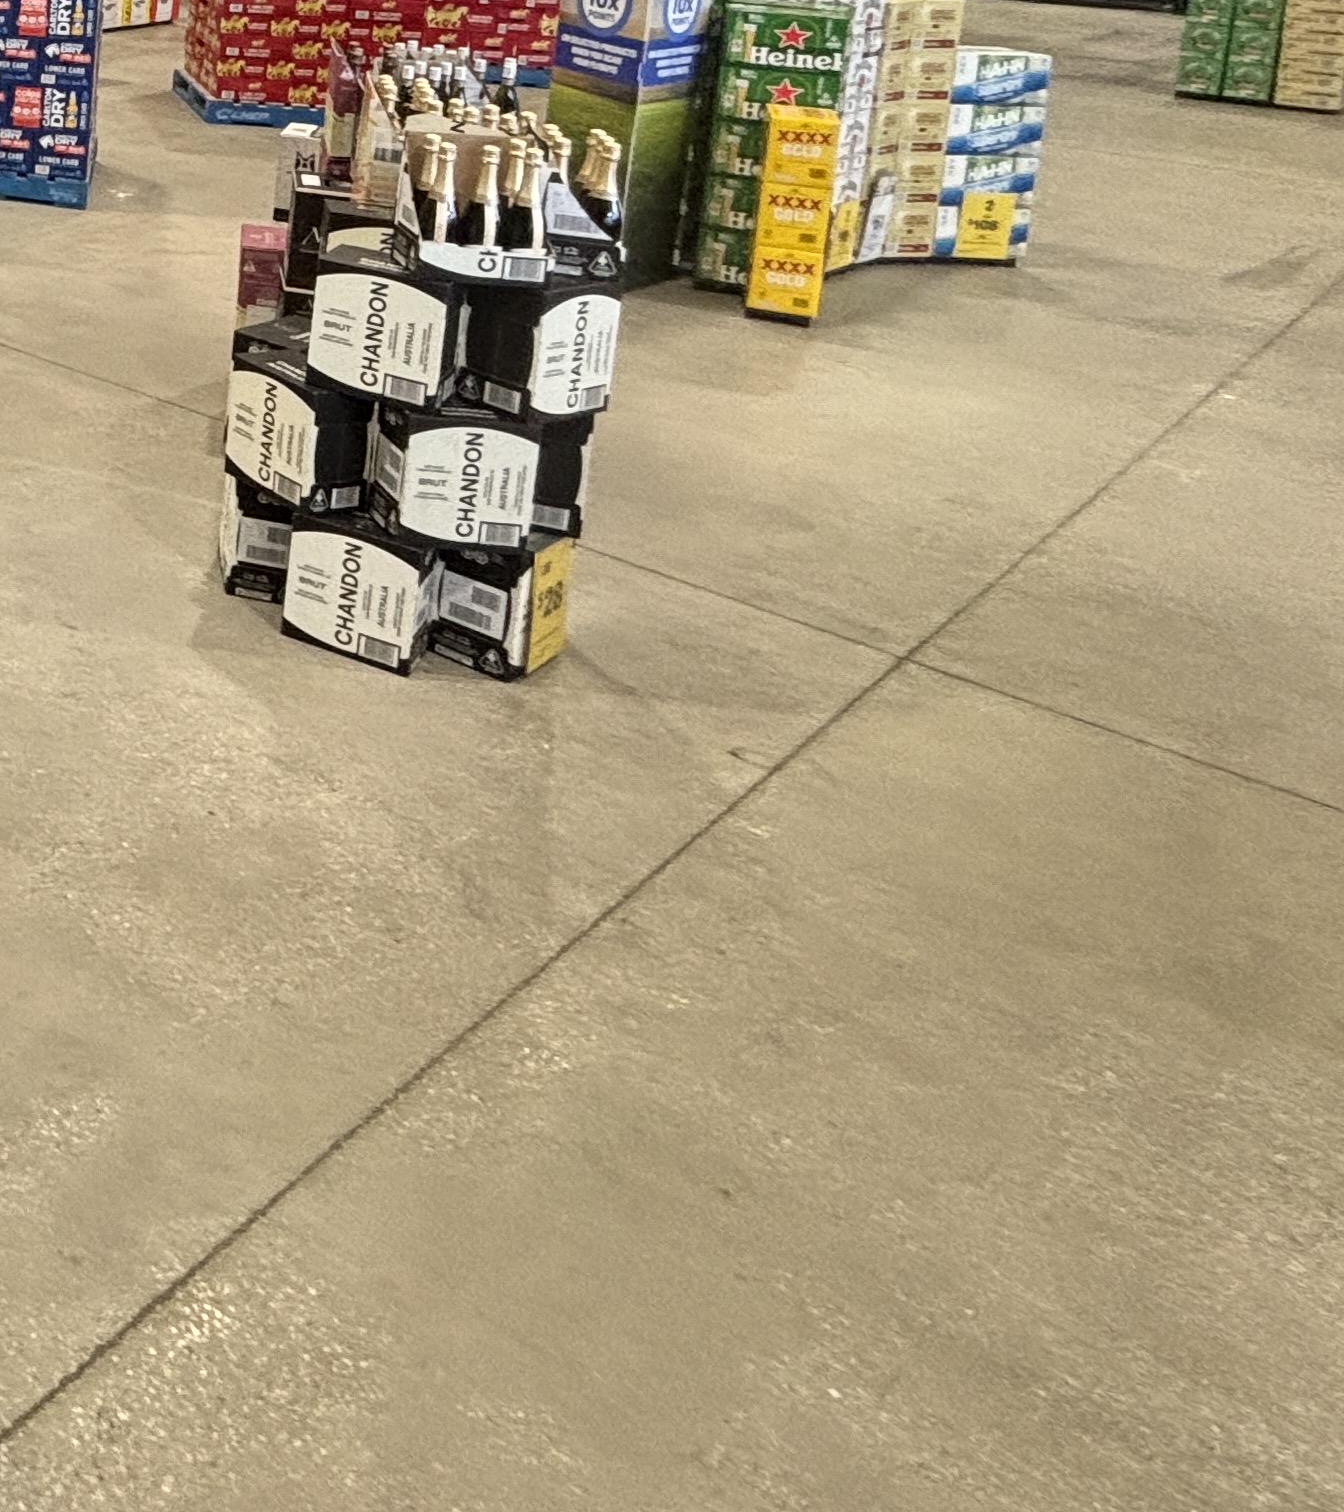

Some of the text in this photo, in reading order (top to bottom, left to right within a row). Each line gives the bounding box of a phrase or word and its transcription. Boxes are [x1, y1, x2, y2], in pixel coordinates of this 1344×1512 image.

[51, 89, 66, 128] DRY
[777, 129, 832, 145] XXXX
[768, 194, 821, 210] XXXX
[762, 258, 815, 275] XXXX
[324, 320, 353, 333] BRUT
[360, 281, 389, 387] CHANDON
[403, 322, 416, 366] AUSTRALIA
[566, 300, 590, 408] CHANDON
[258, 382, 278, 482] CHANDON
[418, 478, 448, 487] BRUT
[455, 432, 485, 537] CHANDON
[335, 541, 363, 646] CHANDON
